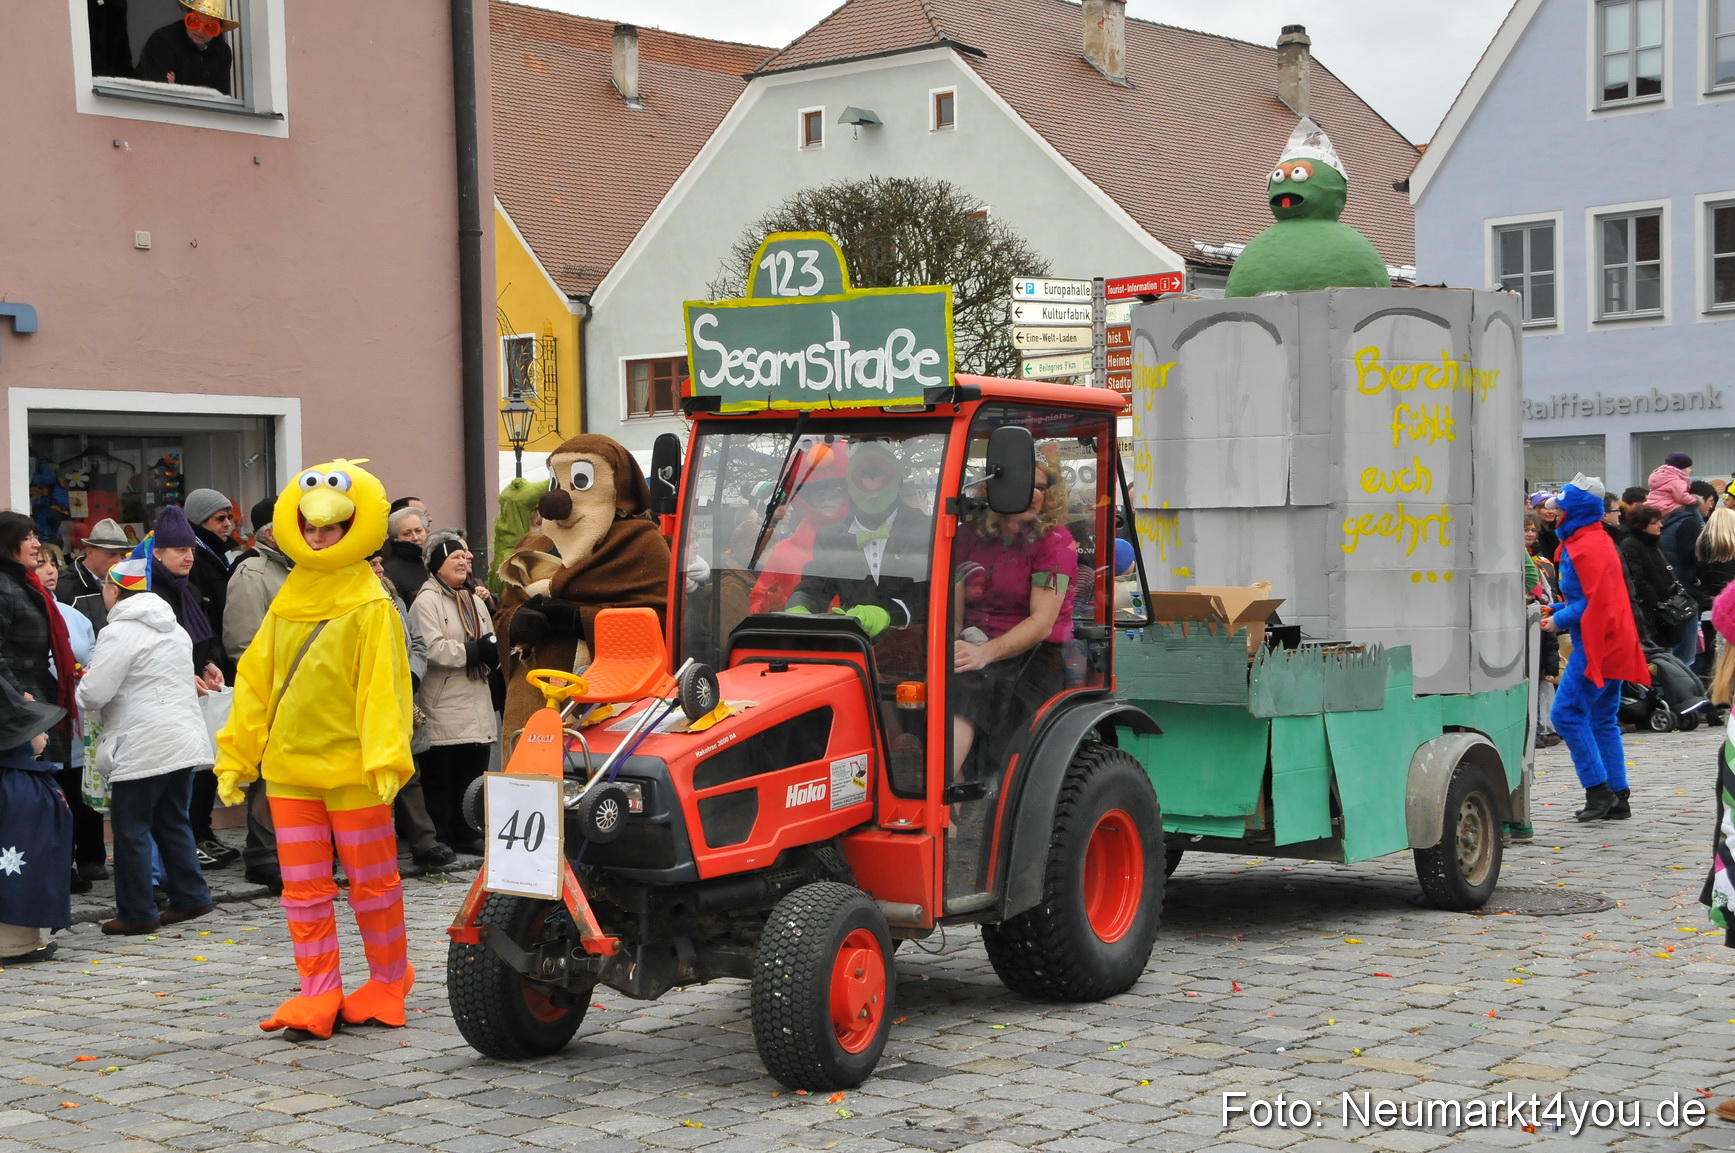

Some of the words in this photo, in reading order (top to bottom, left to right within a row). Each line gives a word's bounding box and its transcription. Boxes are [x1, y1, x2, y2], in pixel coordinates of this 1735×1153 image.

[759, 250, 824, 296] 123
[1107, 281, 1158, 295] Tourist-Information
[1044, 282, 1091, 297] Europahalle
[1042, 307, 1091, 321] Kulturfabrik
[693, 310, 942, 393] Sesamstraße
[1026, 333, 1077, 343] Eine-Welt-Laden
[1107, 332, 1124, 344] hist.
[1069, 361, 1076, 369] km
[1352, 345, 1500, 403] Berchinger
[1107, 375, 1132, 391] Stadtp
[1522, 384, 1722, 419] Raiffeisenbank
[1390, 403, 1456, 448] fühlt
[1360, 457, 1432, 495] euch
[1340, 503, 1453, 557] geehrt
[717, 736, 730, 747] 3000
[785, 777, 828, 809] Hako
[497, 809, 546, 852] 40
